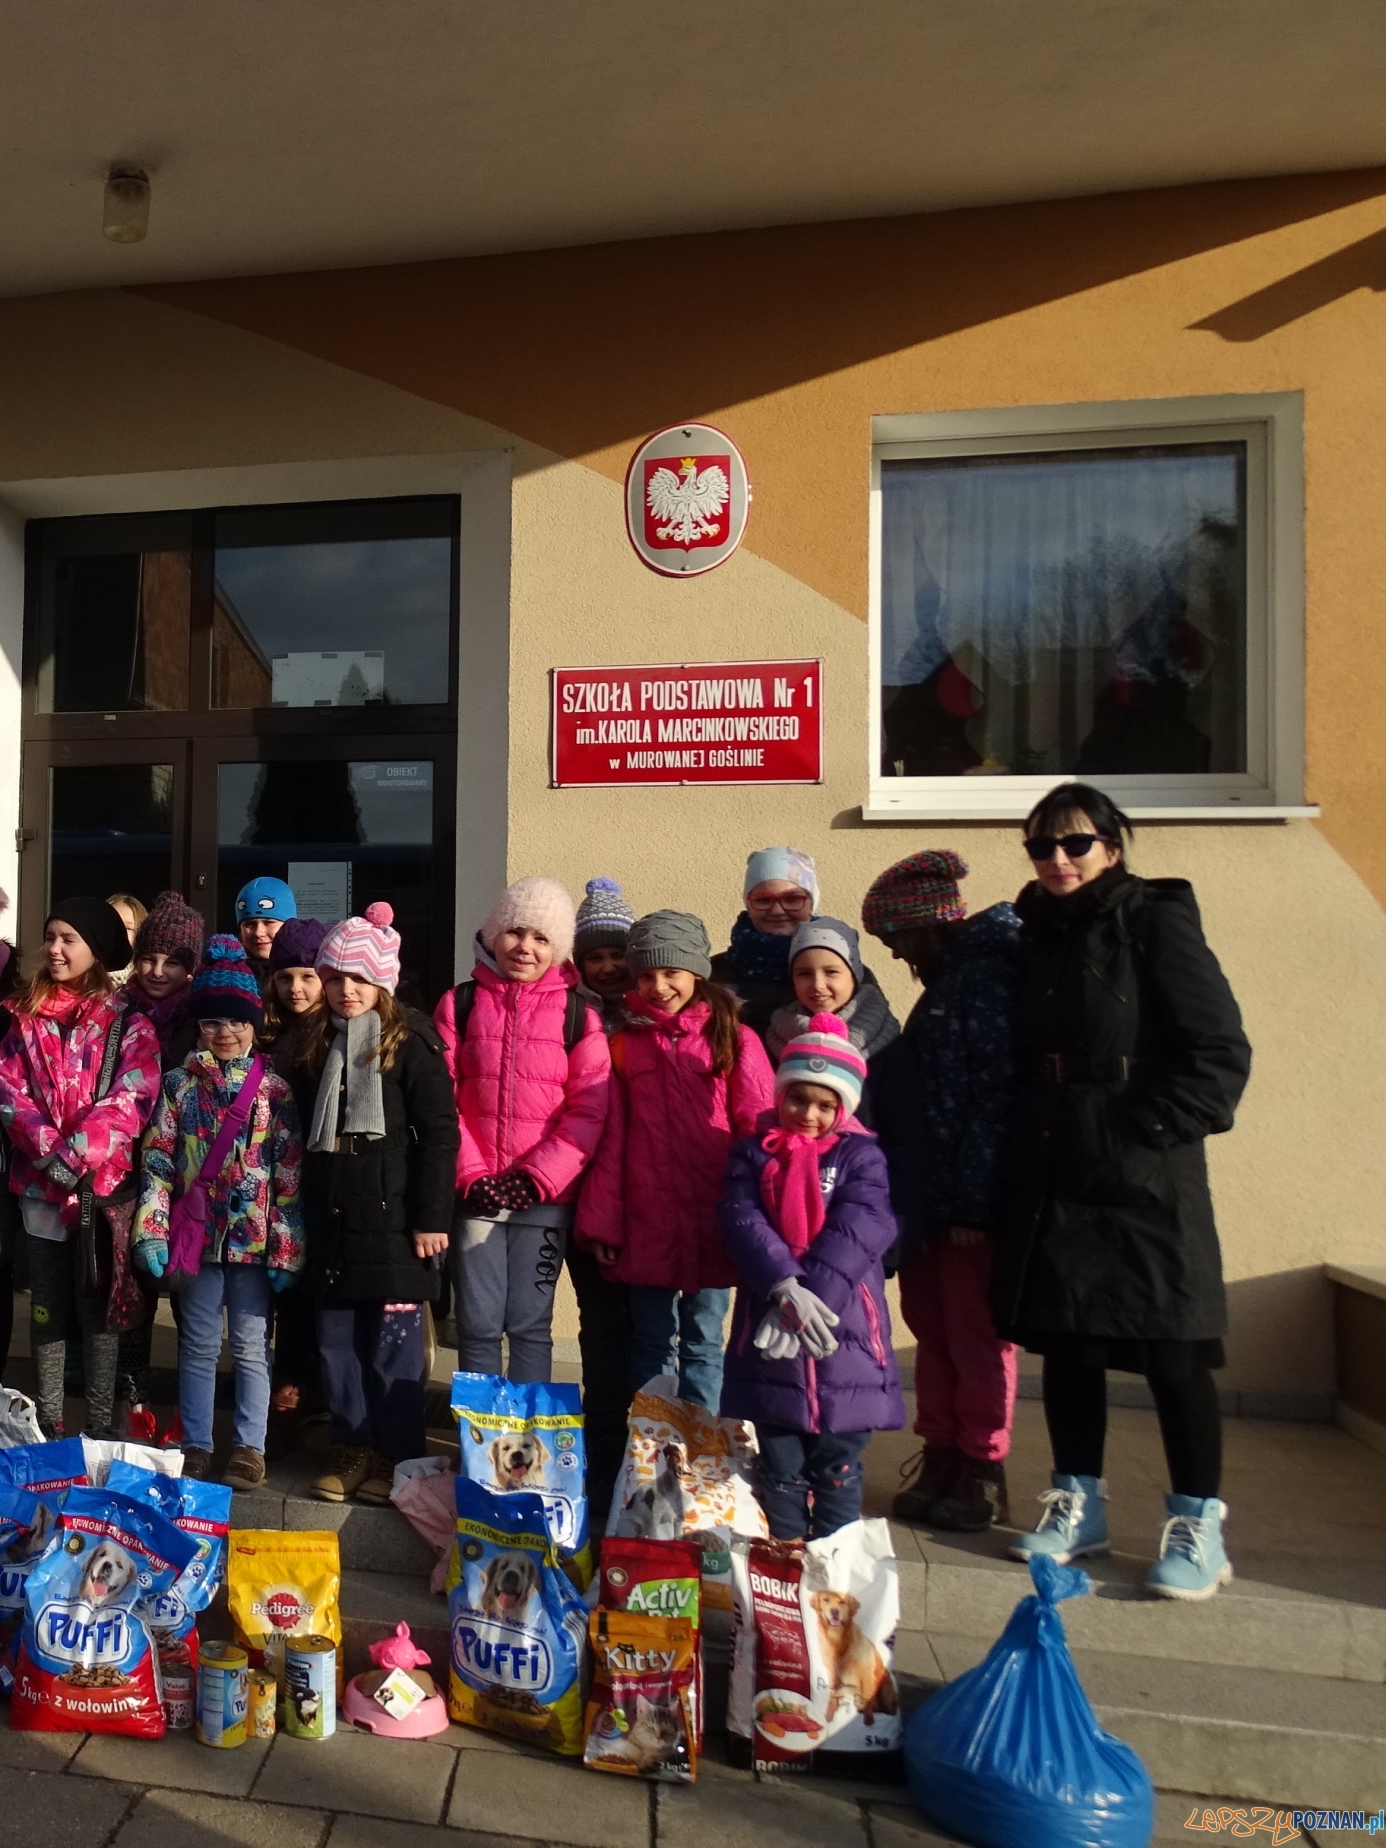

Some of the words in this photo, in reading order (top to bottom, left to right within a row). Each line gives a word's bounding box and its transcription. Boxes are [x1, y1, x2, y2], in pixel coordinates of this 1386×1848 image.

[563, 682, 632, 713] SZKOŁA
[641, 678, 764, 711] PODSTAWOWA
[774, 677, 795, 708] Nr
[803, 676, 813, 708] 1
[658, 716, 799, 743] MARCINKOWSKIEGO
[609, 757, 620, 770] w
[627, 750, 705, 769] MUROWANEJ
[709, 745, 765, 768] GOŚLINIE
[626, 1582, 693, 1611] Activ
[750, 1572, 799, 1602] BOBIK
[250, 1602, 315, 1618] Pedigree
[48, 1611, 122, 1653] PUFFi
[458, 1626, 539, 1682] PUFFi
[603, 1646, 677, 1673] Kitty
